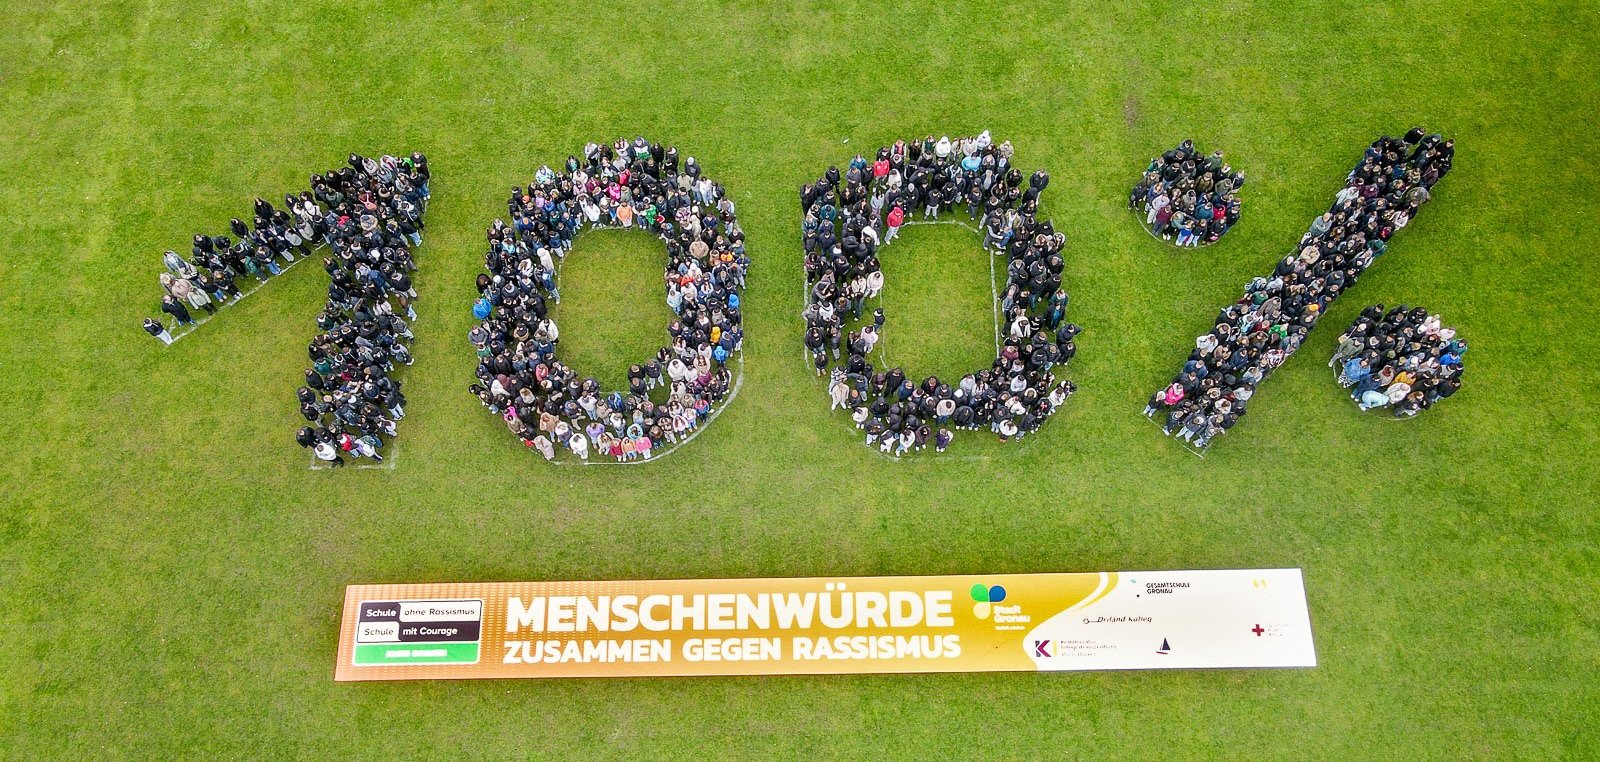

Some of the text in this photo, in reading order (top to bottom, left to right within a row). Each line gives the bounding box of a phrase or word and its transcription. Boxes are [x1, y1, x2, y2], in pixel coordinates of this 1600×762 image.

[366, 608, 398, 617] Schule
[506, 582, 955, 633] MENSCHENWÜRDE
[364, 627, 458, 637] Schule mit Courage
[502, 635, 962, 664] ZUSAMMEN GEGEN RASSISMUS
